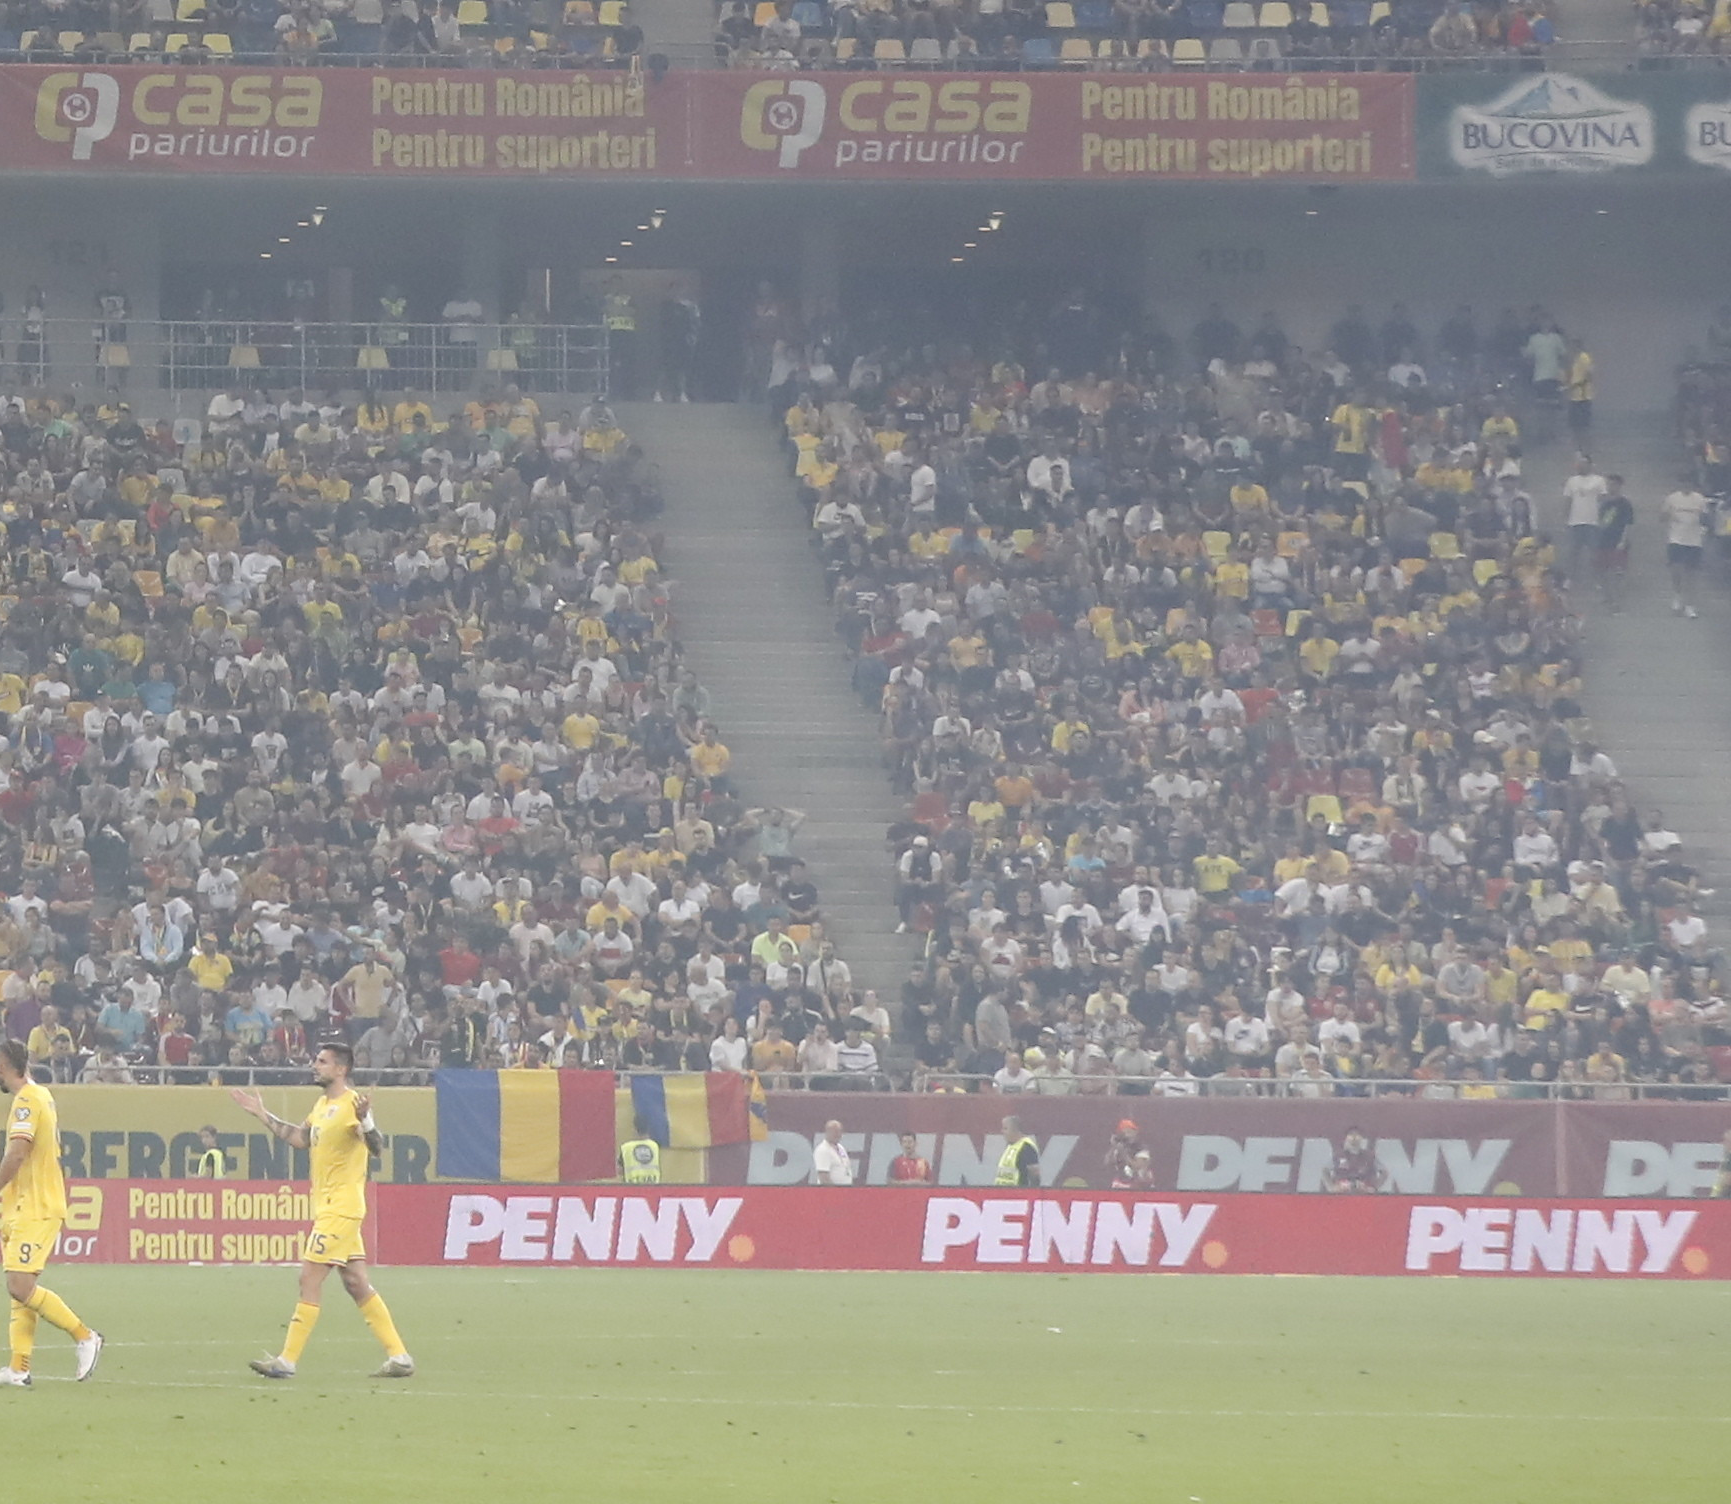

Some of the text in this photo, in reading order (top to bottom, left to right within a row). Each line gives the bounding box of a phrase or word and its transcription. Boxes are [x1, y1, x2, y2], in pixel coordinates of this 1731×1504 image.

[131, 73, 324, 127] casa
[372, 76, 484, 118] Pentru
[840, 80, 1032, 133] casa
[1081, 76, 1360, 121] Pentru România
[128, 129, 316, 163] pariurilor
[372, 127, 657, 171] Pentru suporteri
[835, 134, 1024, 168] pariurilor
[1081, 131, 1373, 177] Pentru suporteri
[1462, 121, 1640, 149] BUCOVINA
[128, 1185, 316, 1221] Pentru Români
[129, 1228, 308, 1264] Pentru suport
[309, 1233, 325, 1254] 15
[443, 1194, 743, 1262] PENNY
[921, 1196, 1219, 1267] PENNY
[1404, 1205, 1700, 1273] PENNY
[18, 1243, 32, 1264] 9
